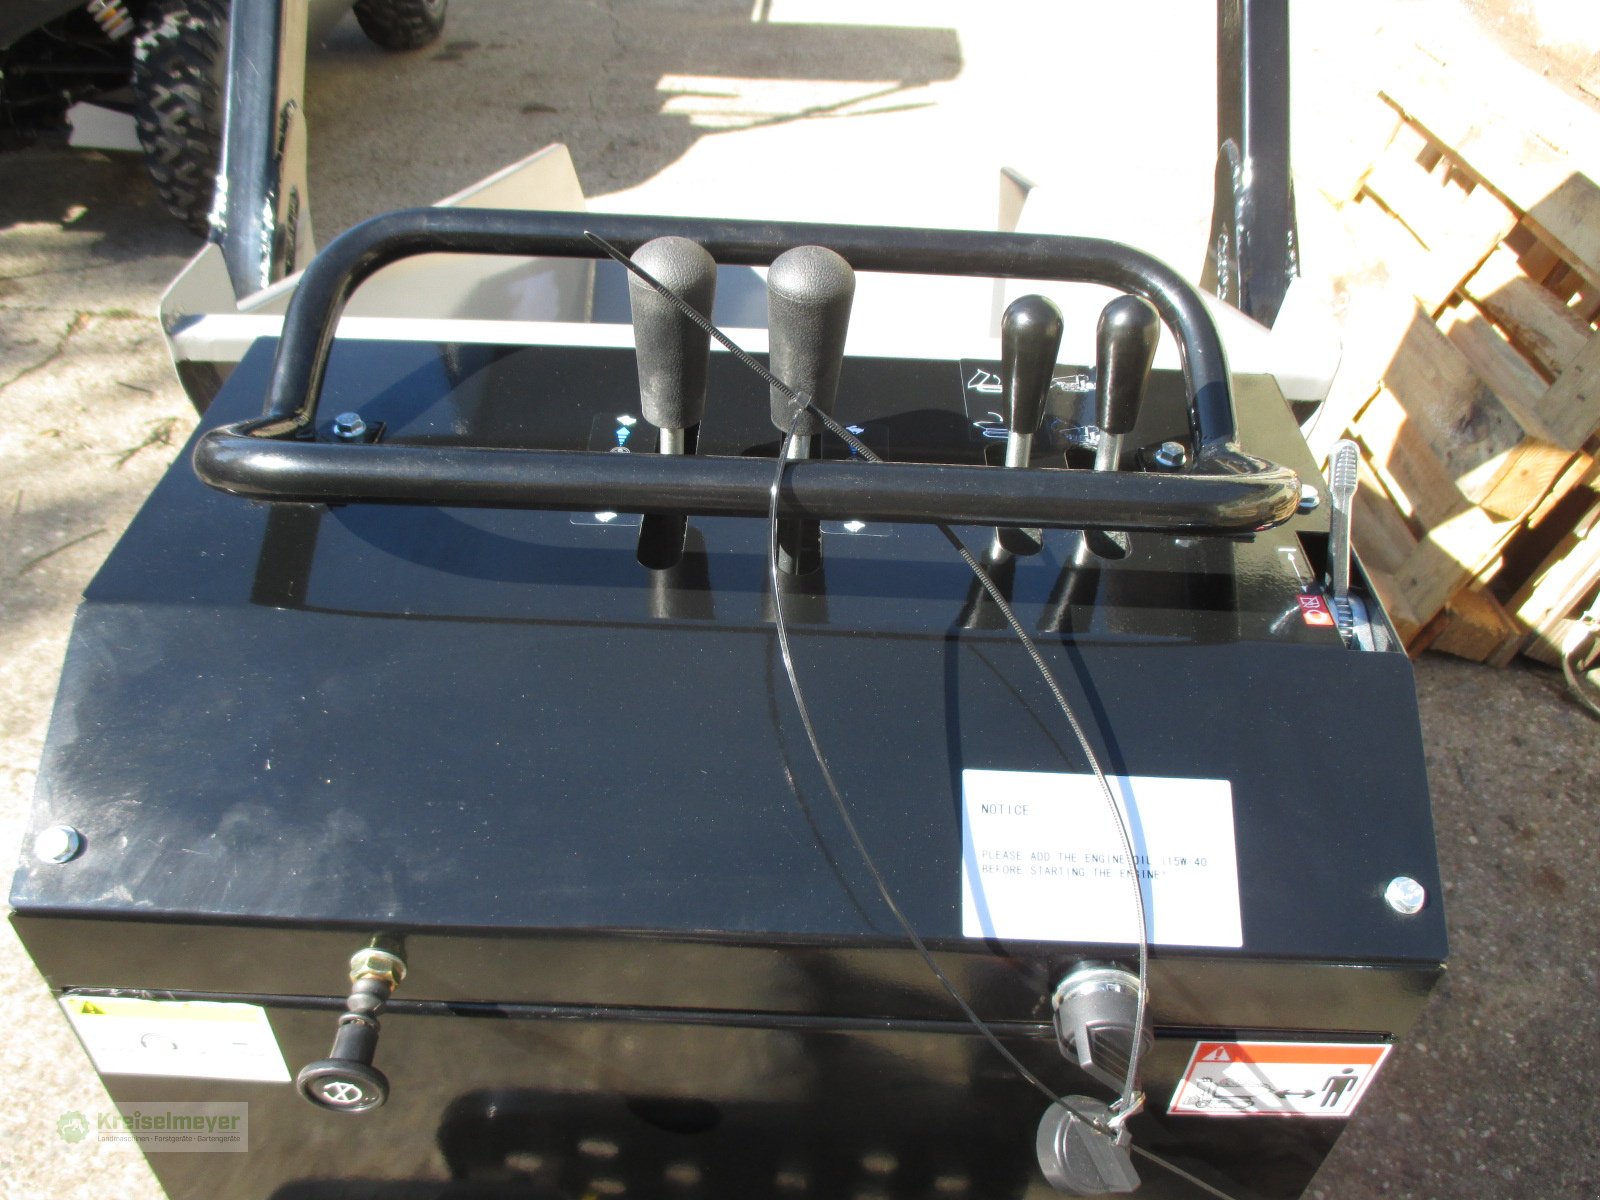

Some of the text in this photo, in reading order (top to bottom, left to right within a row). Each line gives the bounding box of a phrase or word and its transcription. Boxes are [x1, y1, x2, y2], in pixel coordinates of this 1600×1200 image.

[981, 803, 1030, 816] NOTICE
[981, 850, 1023, 861] PLEASE
[1030, 852, 1050, 862] ADD
[1058, 853, 1077, 863] THE
[1085, 854, 1125, 864] ENGINE
[1132, 855, 1151, 865] OIL
[981, 864, 1023, 875] BEFORE
[1030, 866, 1085, 877] STARTING
[1094, 868, 1112, 878] THE
